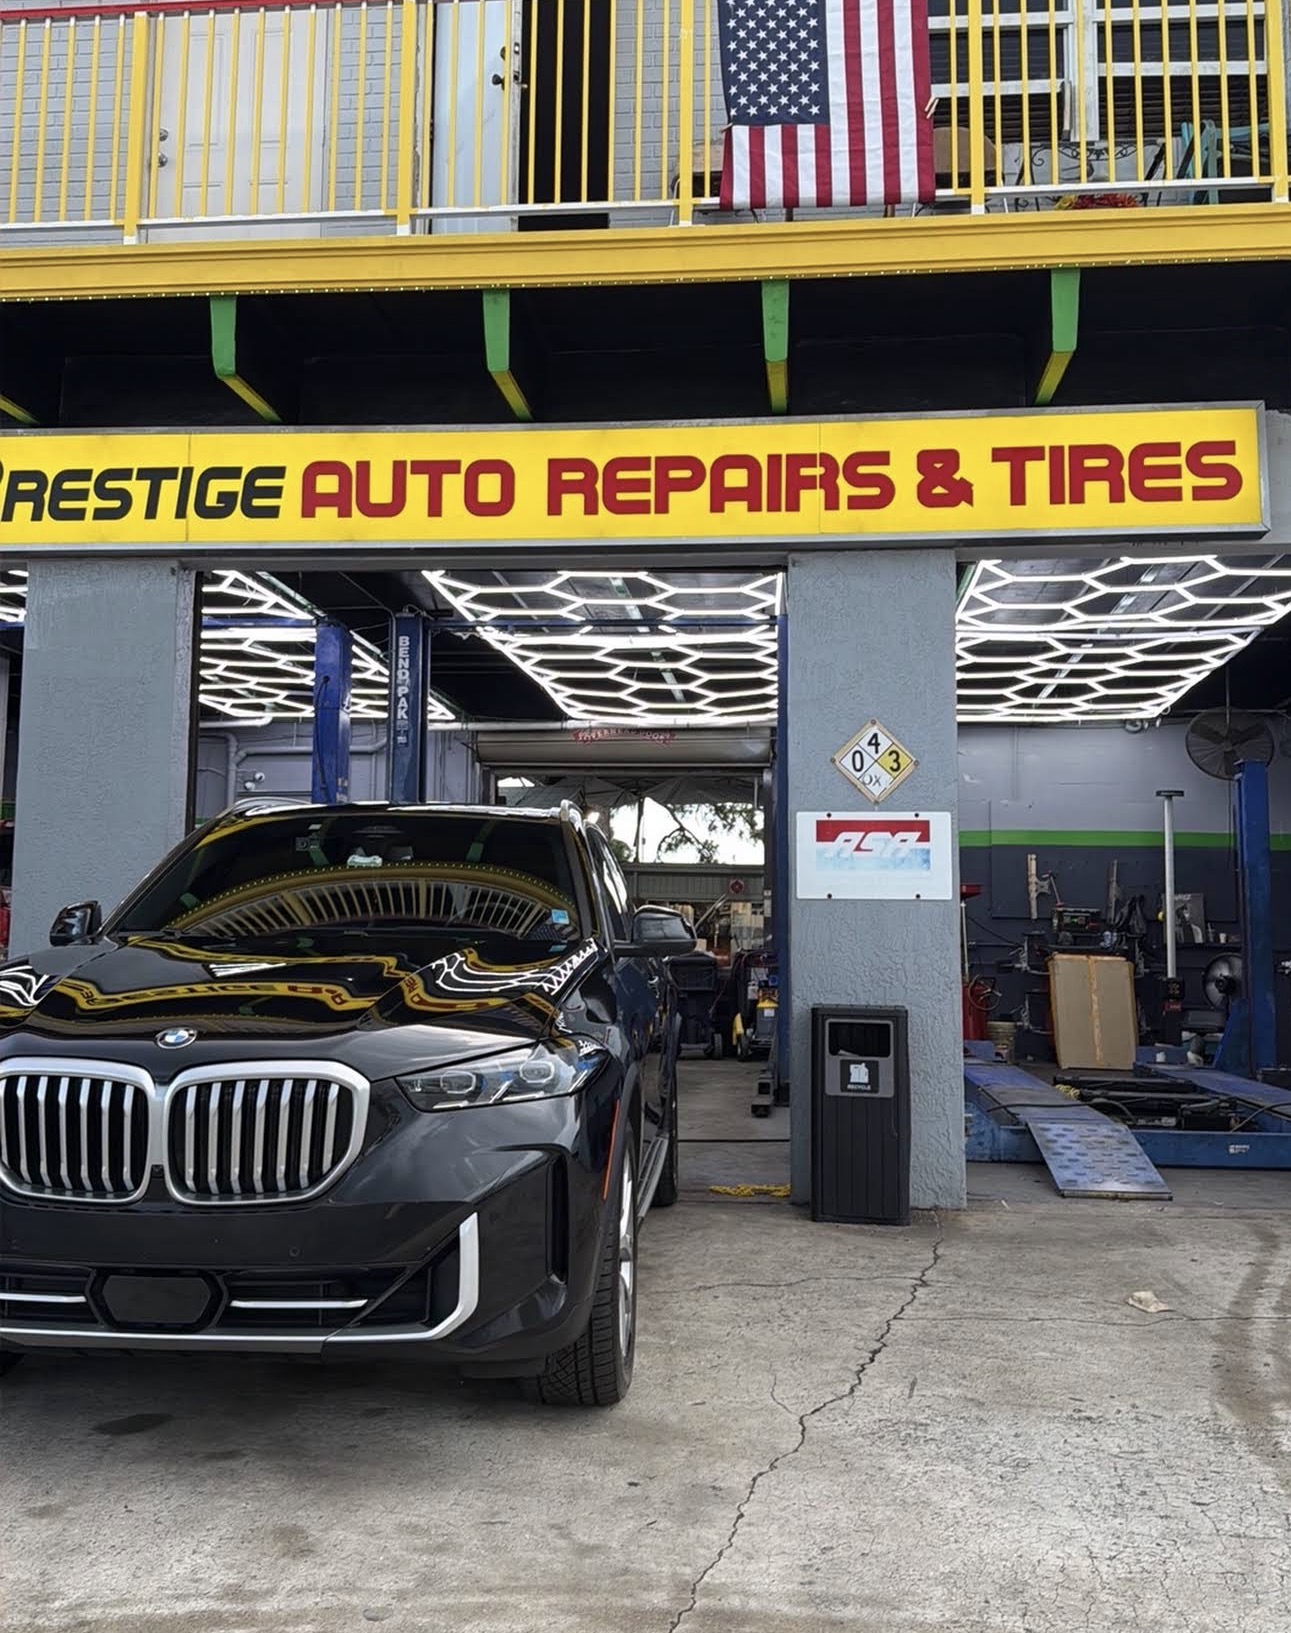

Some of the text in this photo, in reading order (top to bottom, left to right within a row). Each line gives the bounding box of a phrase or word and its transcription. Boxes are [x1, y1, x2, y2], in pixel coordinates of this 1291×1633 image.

[0, 440, 1243, 521] RESTIGE AUTO REPAIRS & TIRES
[867, 732, 881, 754] 4
[851, 750, 864, 772] 0
[888, 750, 901, 772] 3
